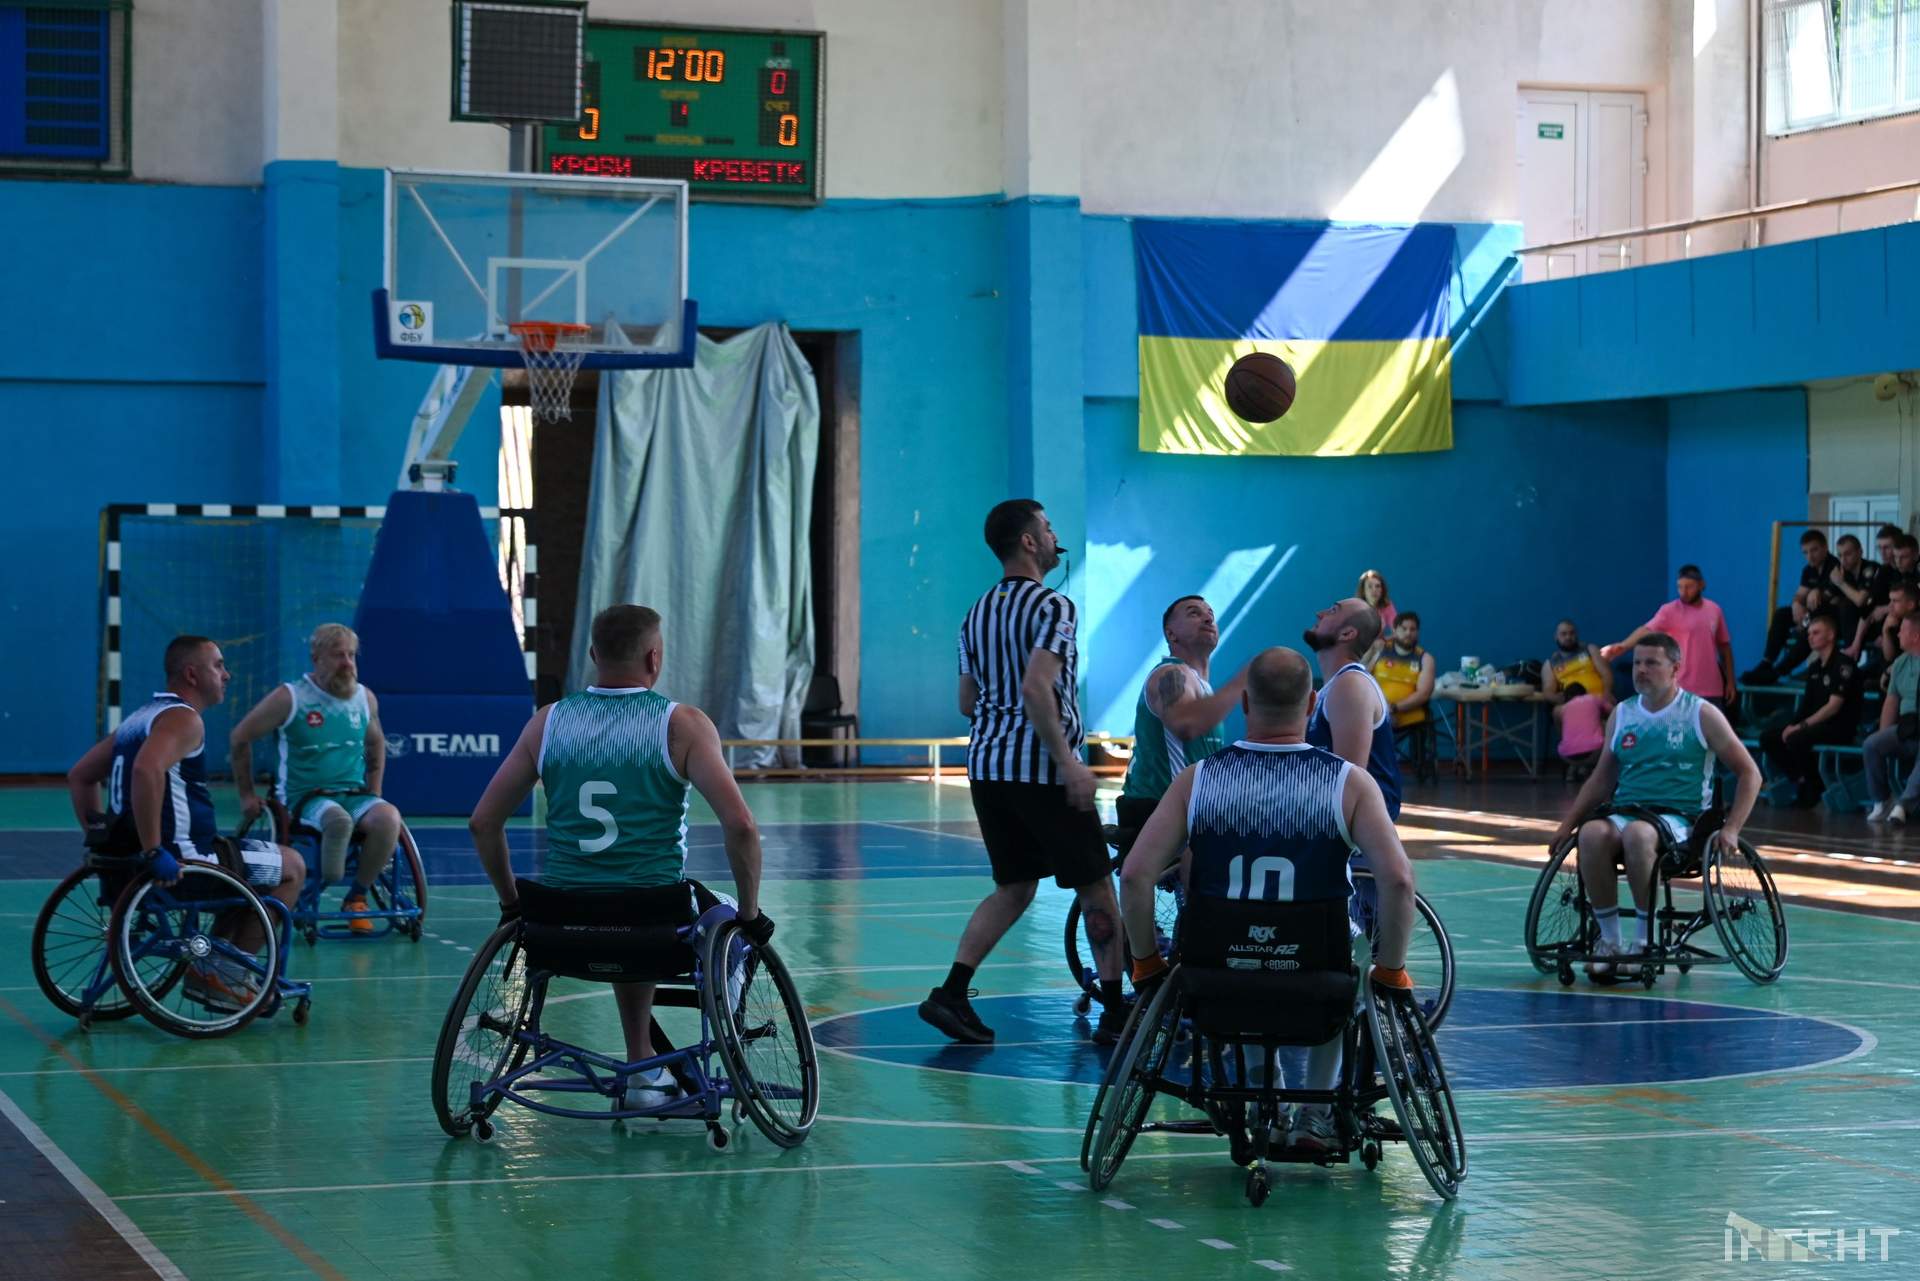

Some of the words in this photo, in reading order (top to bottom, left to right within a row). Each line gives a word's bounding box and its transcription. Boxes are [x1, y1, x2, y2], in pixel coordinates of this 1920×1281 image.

[778, 114, 798, 146] 0
[410, 733, 500, 753] ТЕМП
[578, 780, 618, 852] 5
[1226, 854, 1295, 901] 10
[1228, 944, 1273, 953] ALLSTAR
